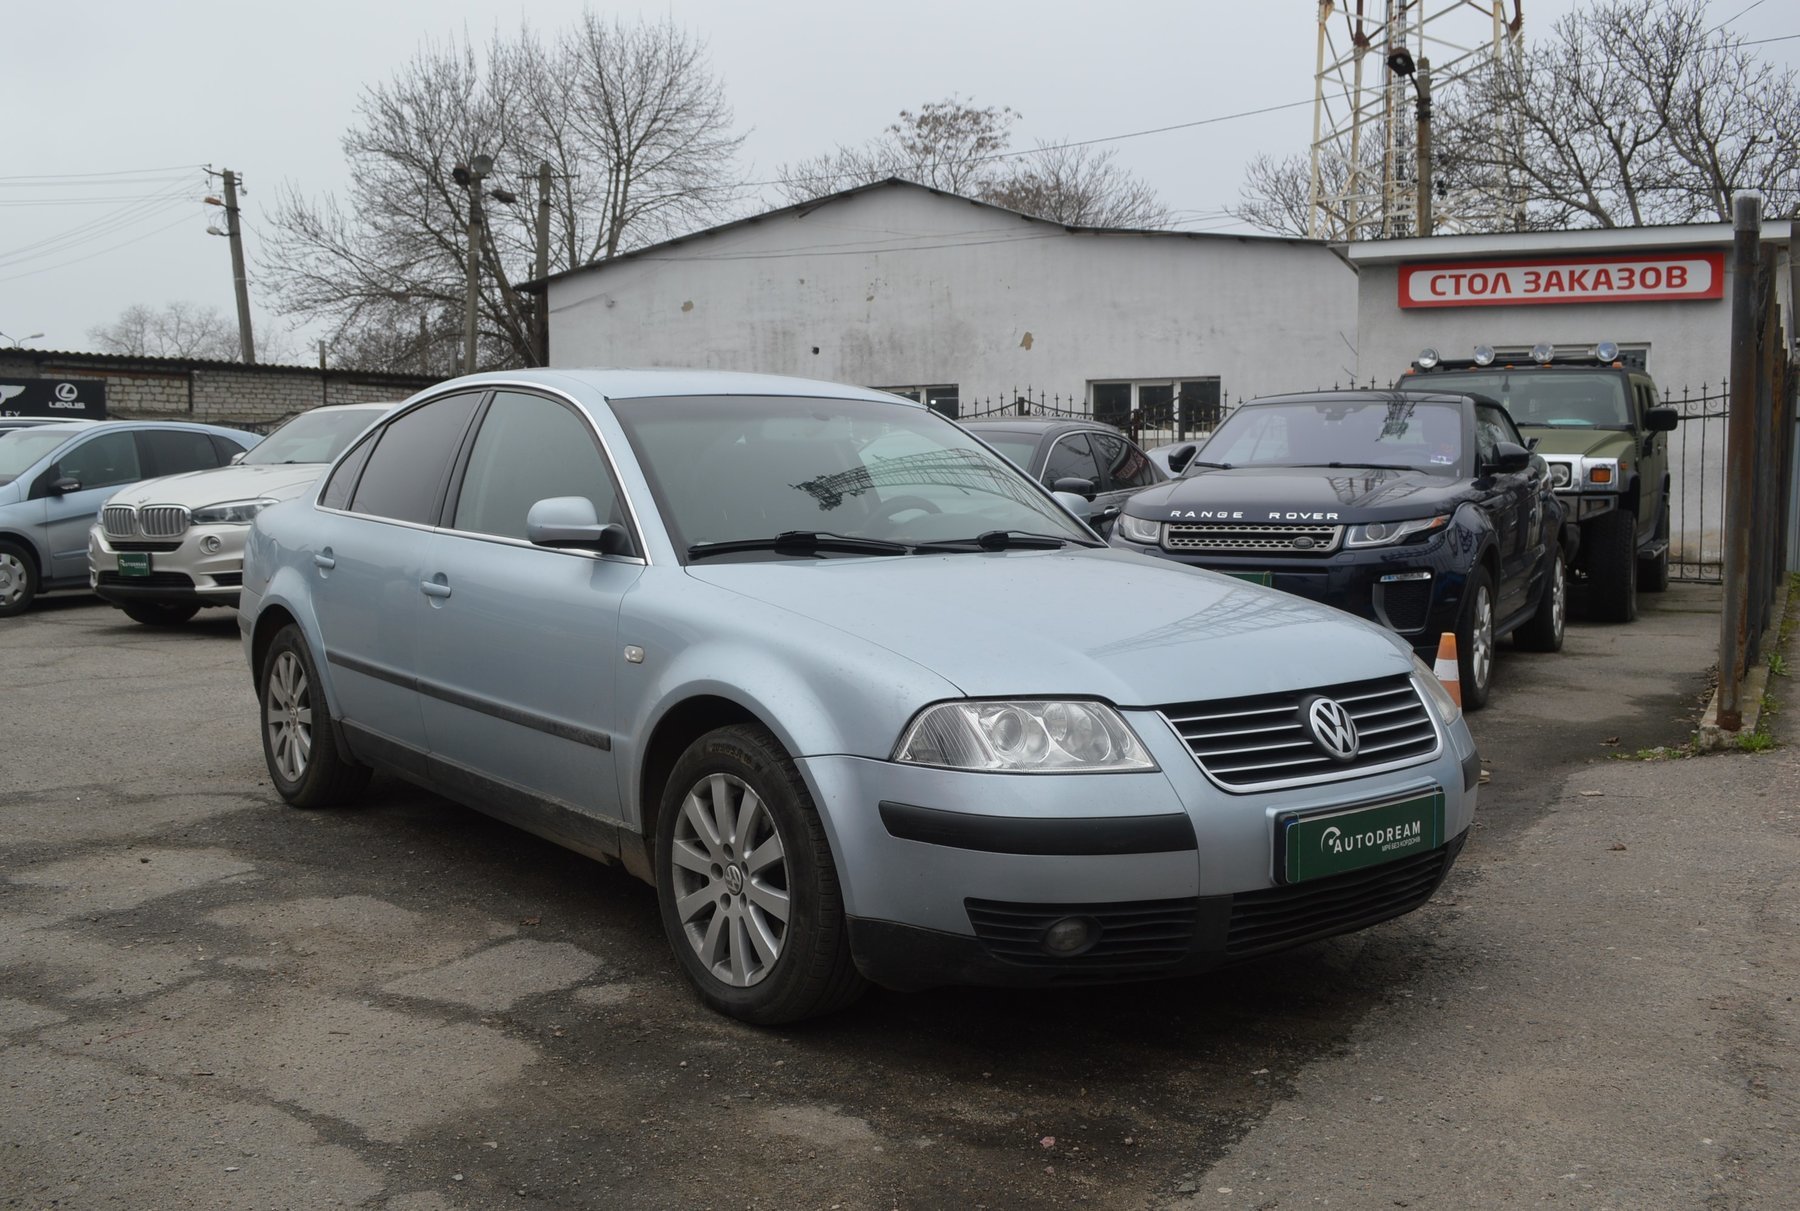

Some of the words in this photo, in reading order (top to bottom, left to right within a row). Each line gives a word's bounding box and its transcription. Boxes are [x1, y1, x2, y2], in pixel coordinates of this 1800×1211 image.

[1430, 272, 1512, 296] СТОЛ
[1523, 265, 1688, 294] ЗАКАЗОВ
[48, 401, 86, 409] LEXUS
[1170, 510, 1244, 519] RANGE
[1268, 512, 1339, 520] ROVER
[1333, 820, 1421, 854] AUTODREAM
